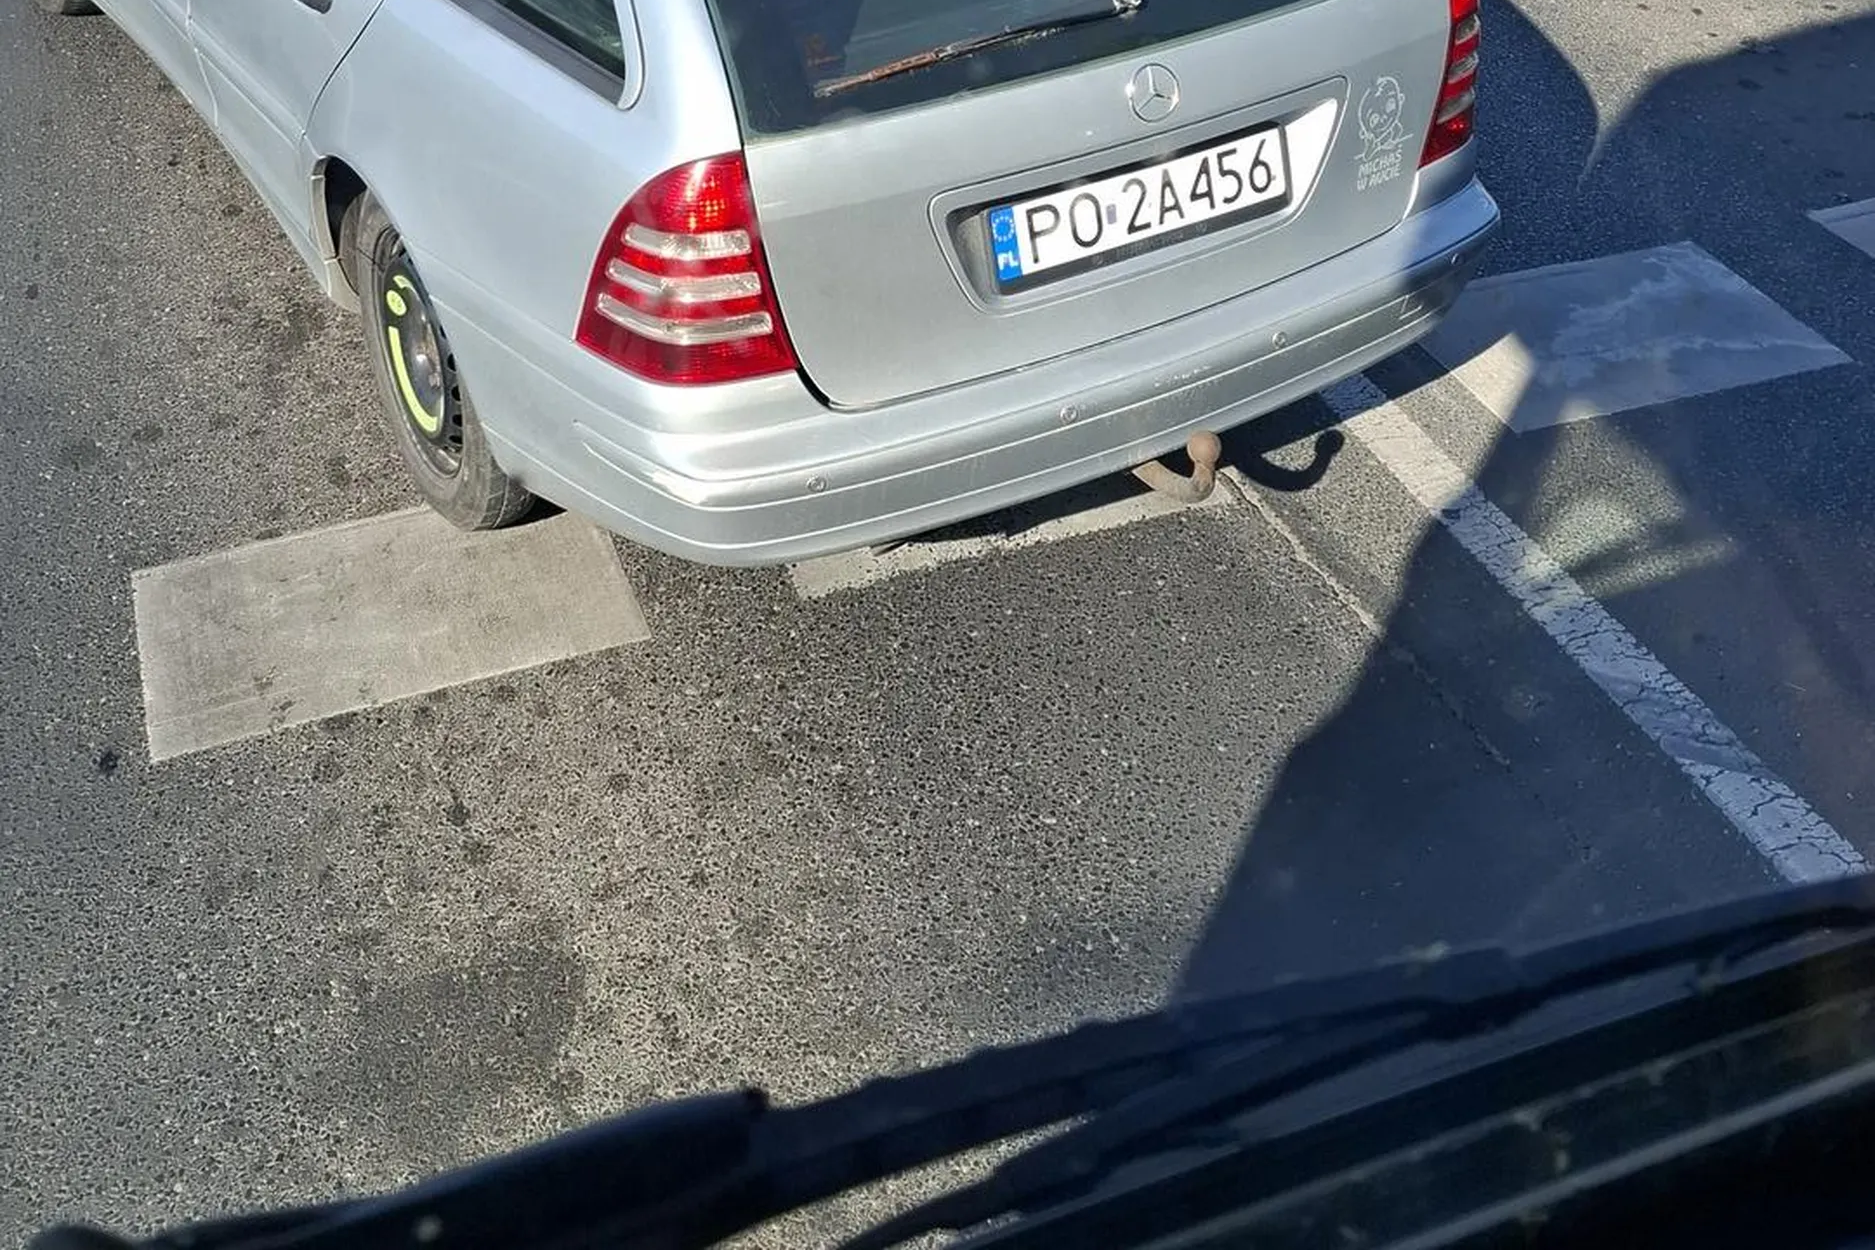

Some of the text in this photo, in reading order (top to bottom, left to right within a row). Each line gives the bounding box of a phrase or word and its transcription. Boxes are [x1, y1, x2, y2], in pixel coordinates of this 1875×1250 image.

[1025, 138, 1273, 264] PO 2A456
[998, 251, 1019, 270] PL
